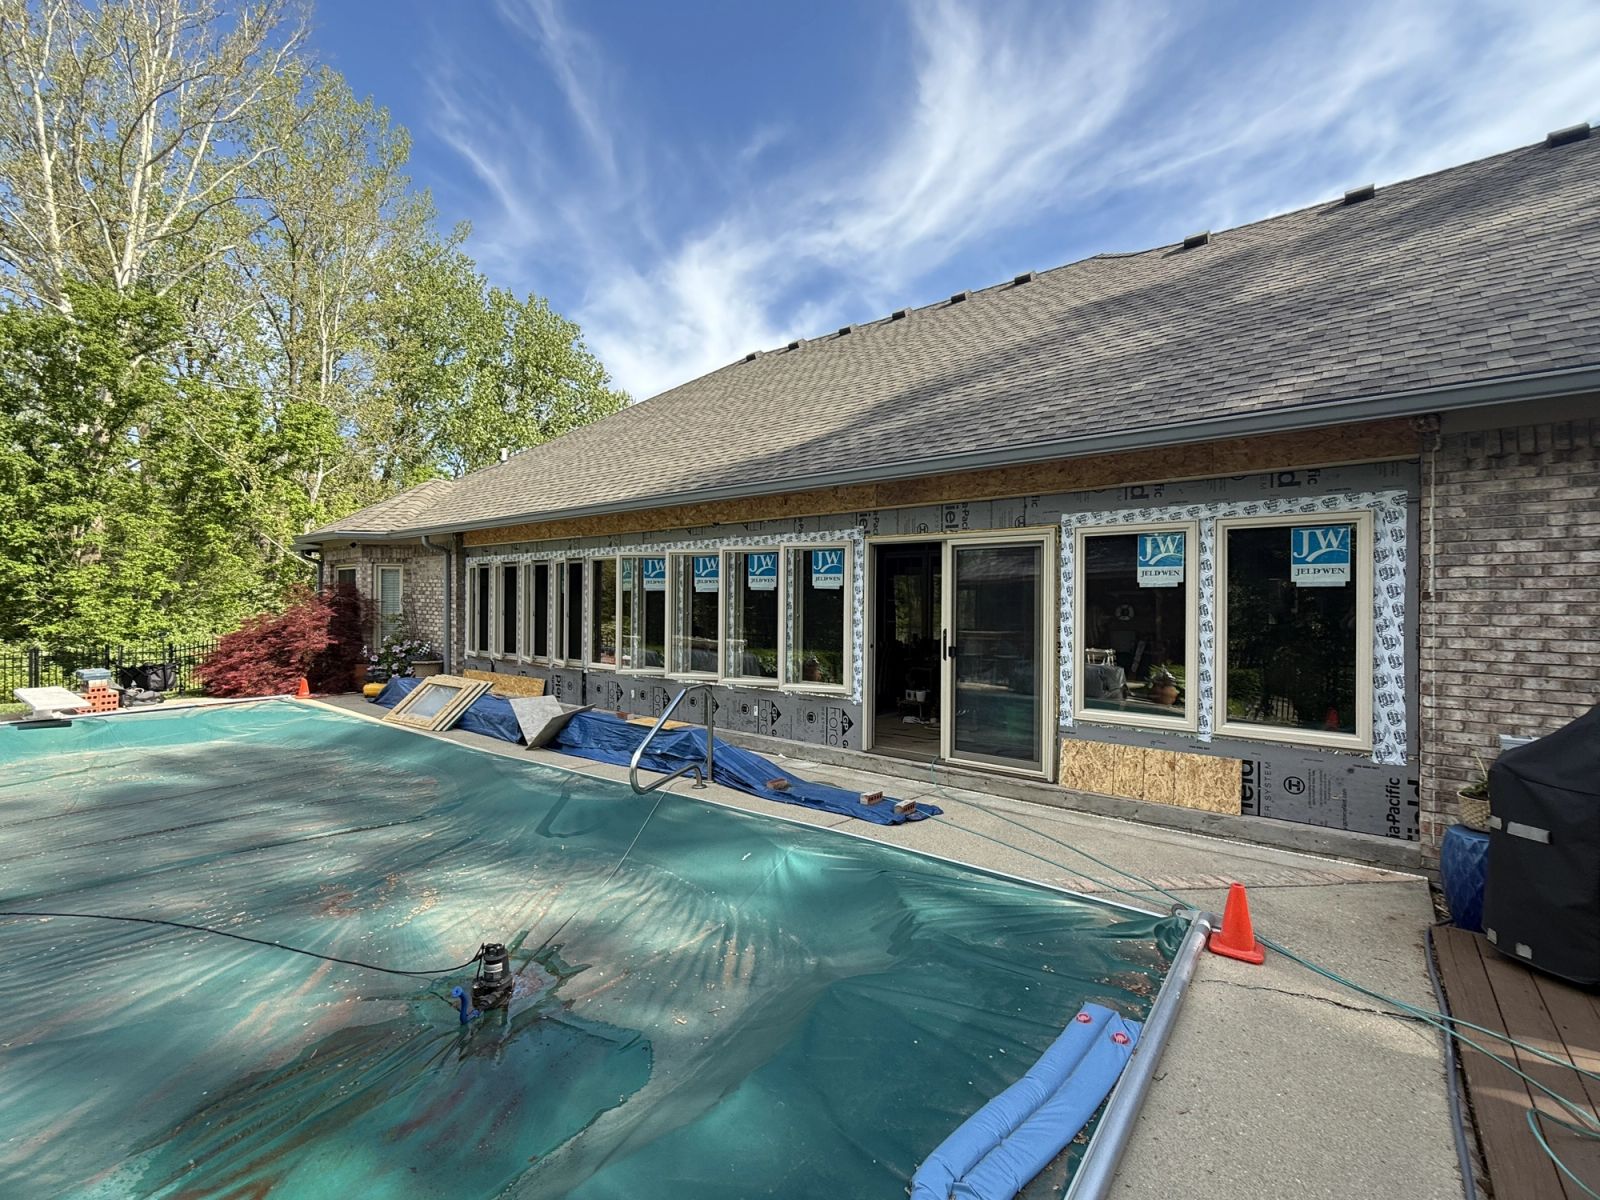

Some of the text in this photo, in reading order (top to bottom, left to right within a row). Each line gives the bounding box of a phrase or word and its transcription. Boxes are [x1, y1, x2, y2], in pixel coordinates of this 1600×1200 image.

[1139, 534, 1181, 562] JW
[1293, 528, 1348, 558] JW
[695, 557, 719, 574] JW
[749, 554, 775, 573] JW
[813, 550, 842, 570] JW
[842, 715, 849, 731] GP
[1263, 761, 1272, 801] SYSTEM
